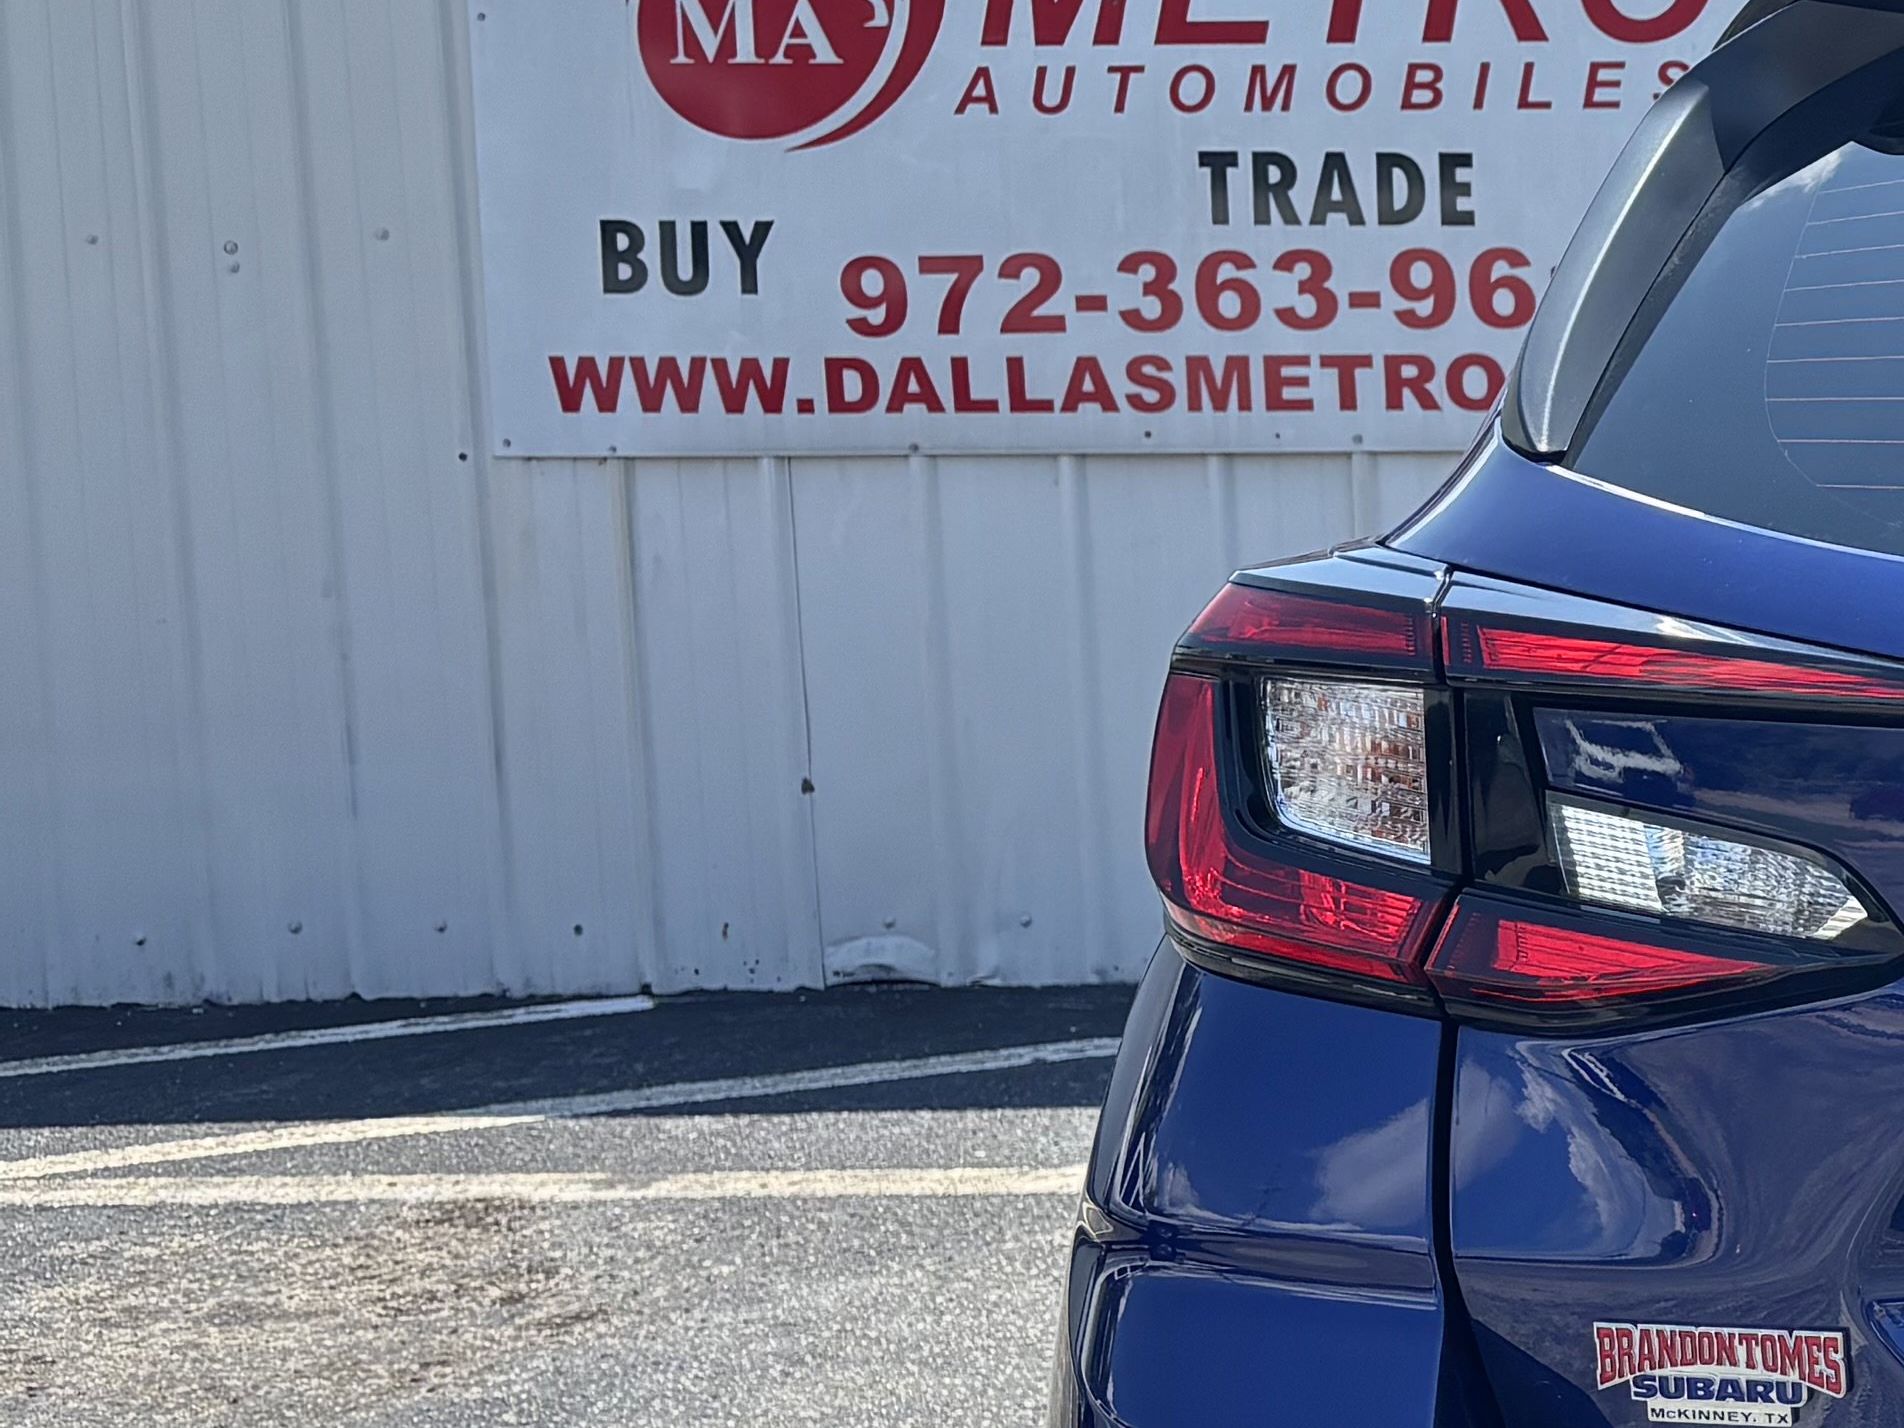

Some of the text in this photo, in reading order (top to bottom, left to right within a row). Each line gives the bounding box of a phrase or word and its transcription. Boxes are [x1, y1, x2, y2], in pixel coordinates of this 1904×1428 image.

[1198, 150, 1476, 227] TRADE
[598, 218, 776, 297] BUY
[839, 246, 1556, 339] 972-363-96
[1632, 1374, 1806, 1406] SUBARU
[1763, 1412, 1790, 1424] TX
